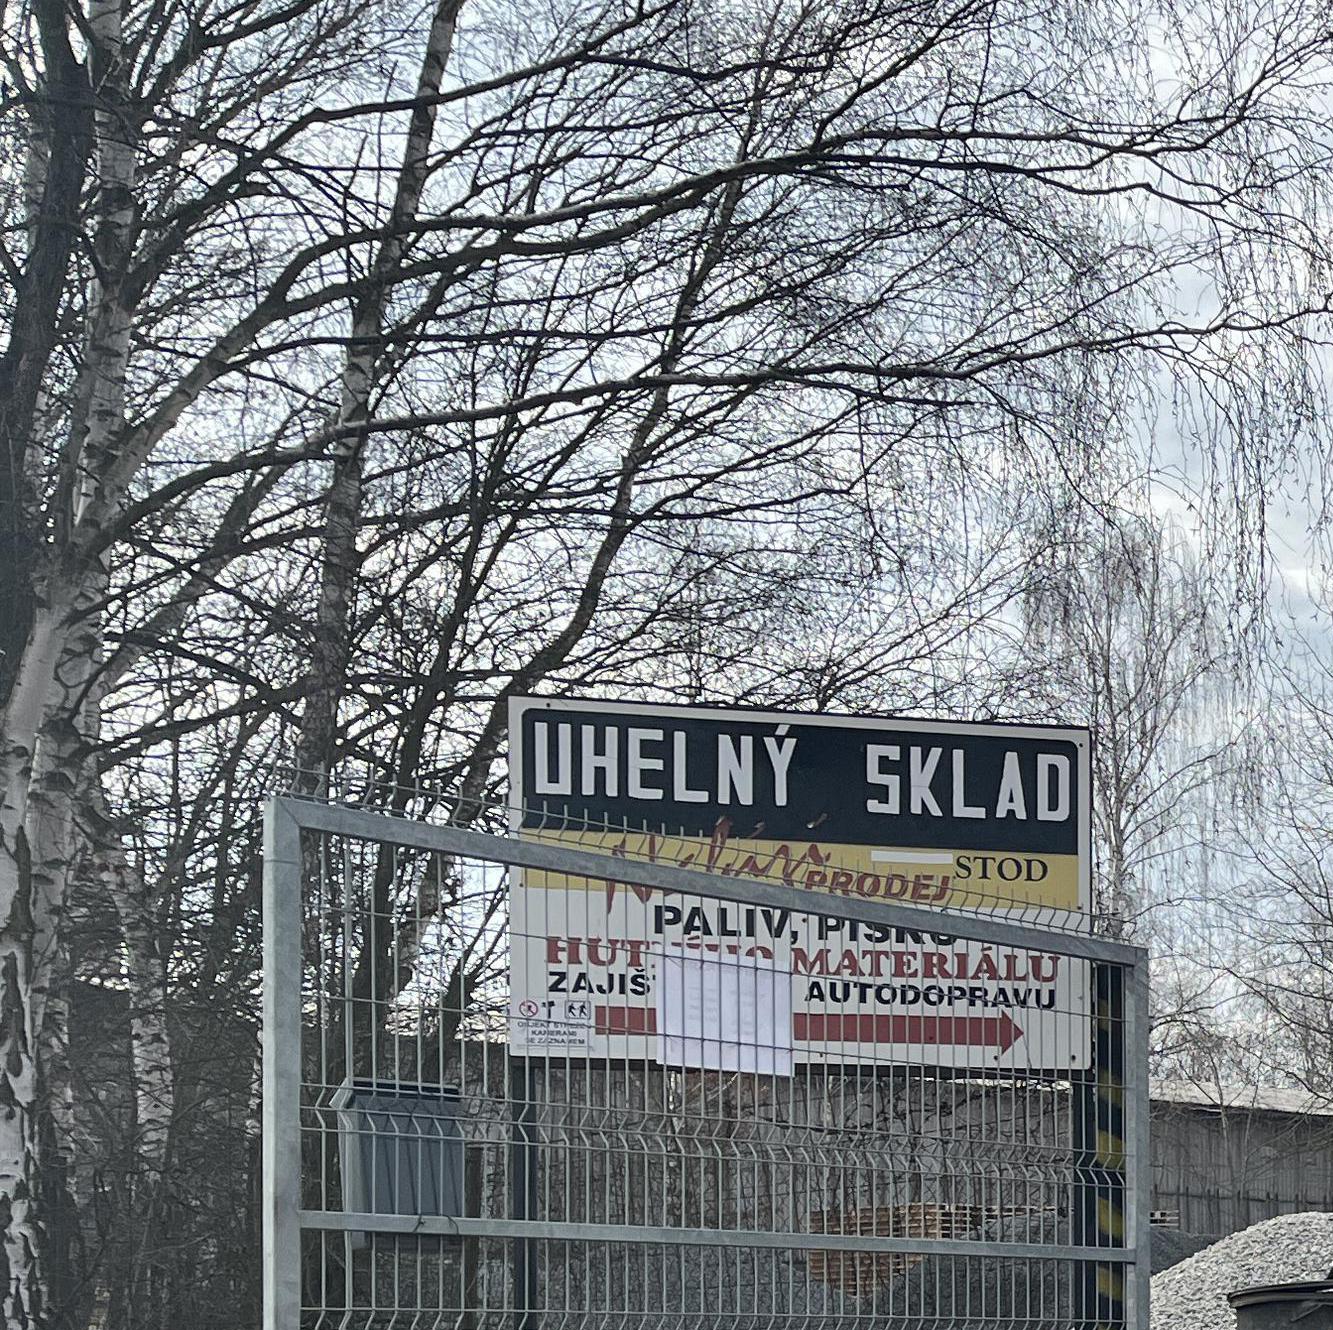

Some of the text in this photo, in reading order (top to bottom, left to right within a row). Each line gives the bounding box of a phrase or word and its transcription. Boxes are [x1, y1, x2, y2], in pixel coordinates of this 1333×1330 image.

[534, 721, 1071, 822] UHELNÝ SKLAD
[954, 855, 1049, 882] STOD
[789, 945, 1061, 983] MATERIÁLU
[804, 981, 1056, 1010] AUTODOPRAVU
